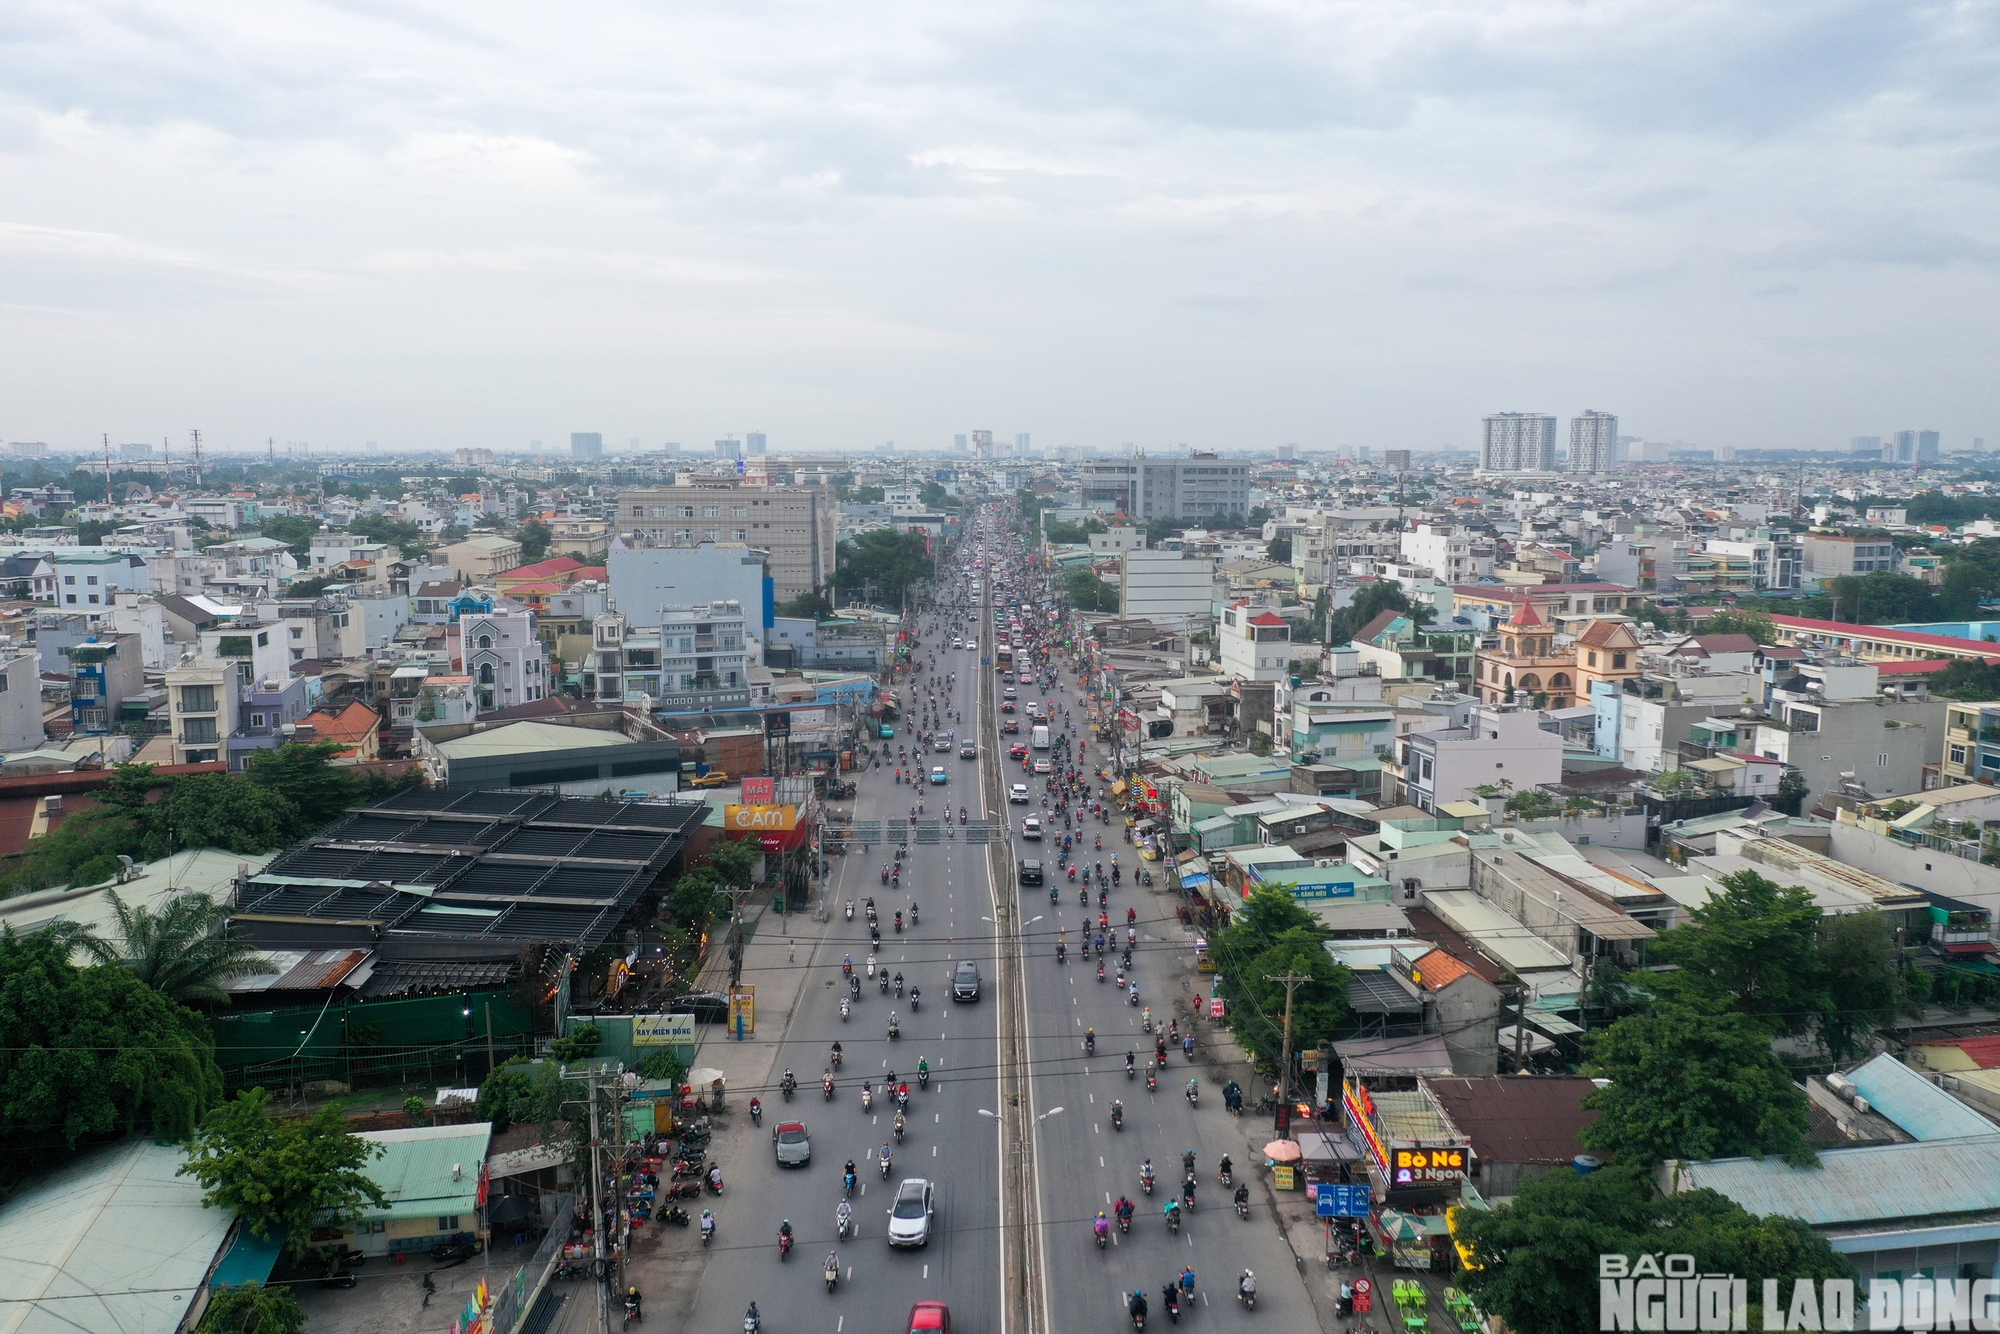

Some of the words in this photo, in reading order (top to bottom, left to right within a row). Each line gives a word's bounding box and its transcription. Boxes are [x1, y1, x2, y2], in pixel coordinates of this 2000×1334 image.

[746, 780, 770, 794] MẮT
[652, 1027, 670, 1036] MIỀN
[1398, 1151, 1427, 1168] Bò
[1432, 1150, 1462, 1167] Né
[1414, 1169, 1423, 1180] 3
[1425, 1167, 1462, 1182] Ngon
